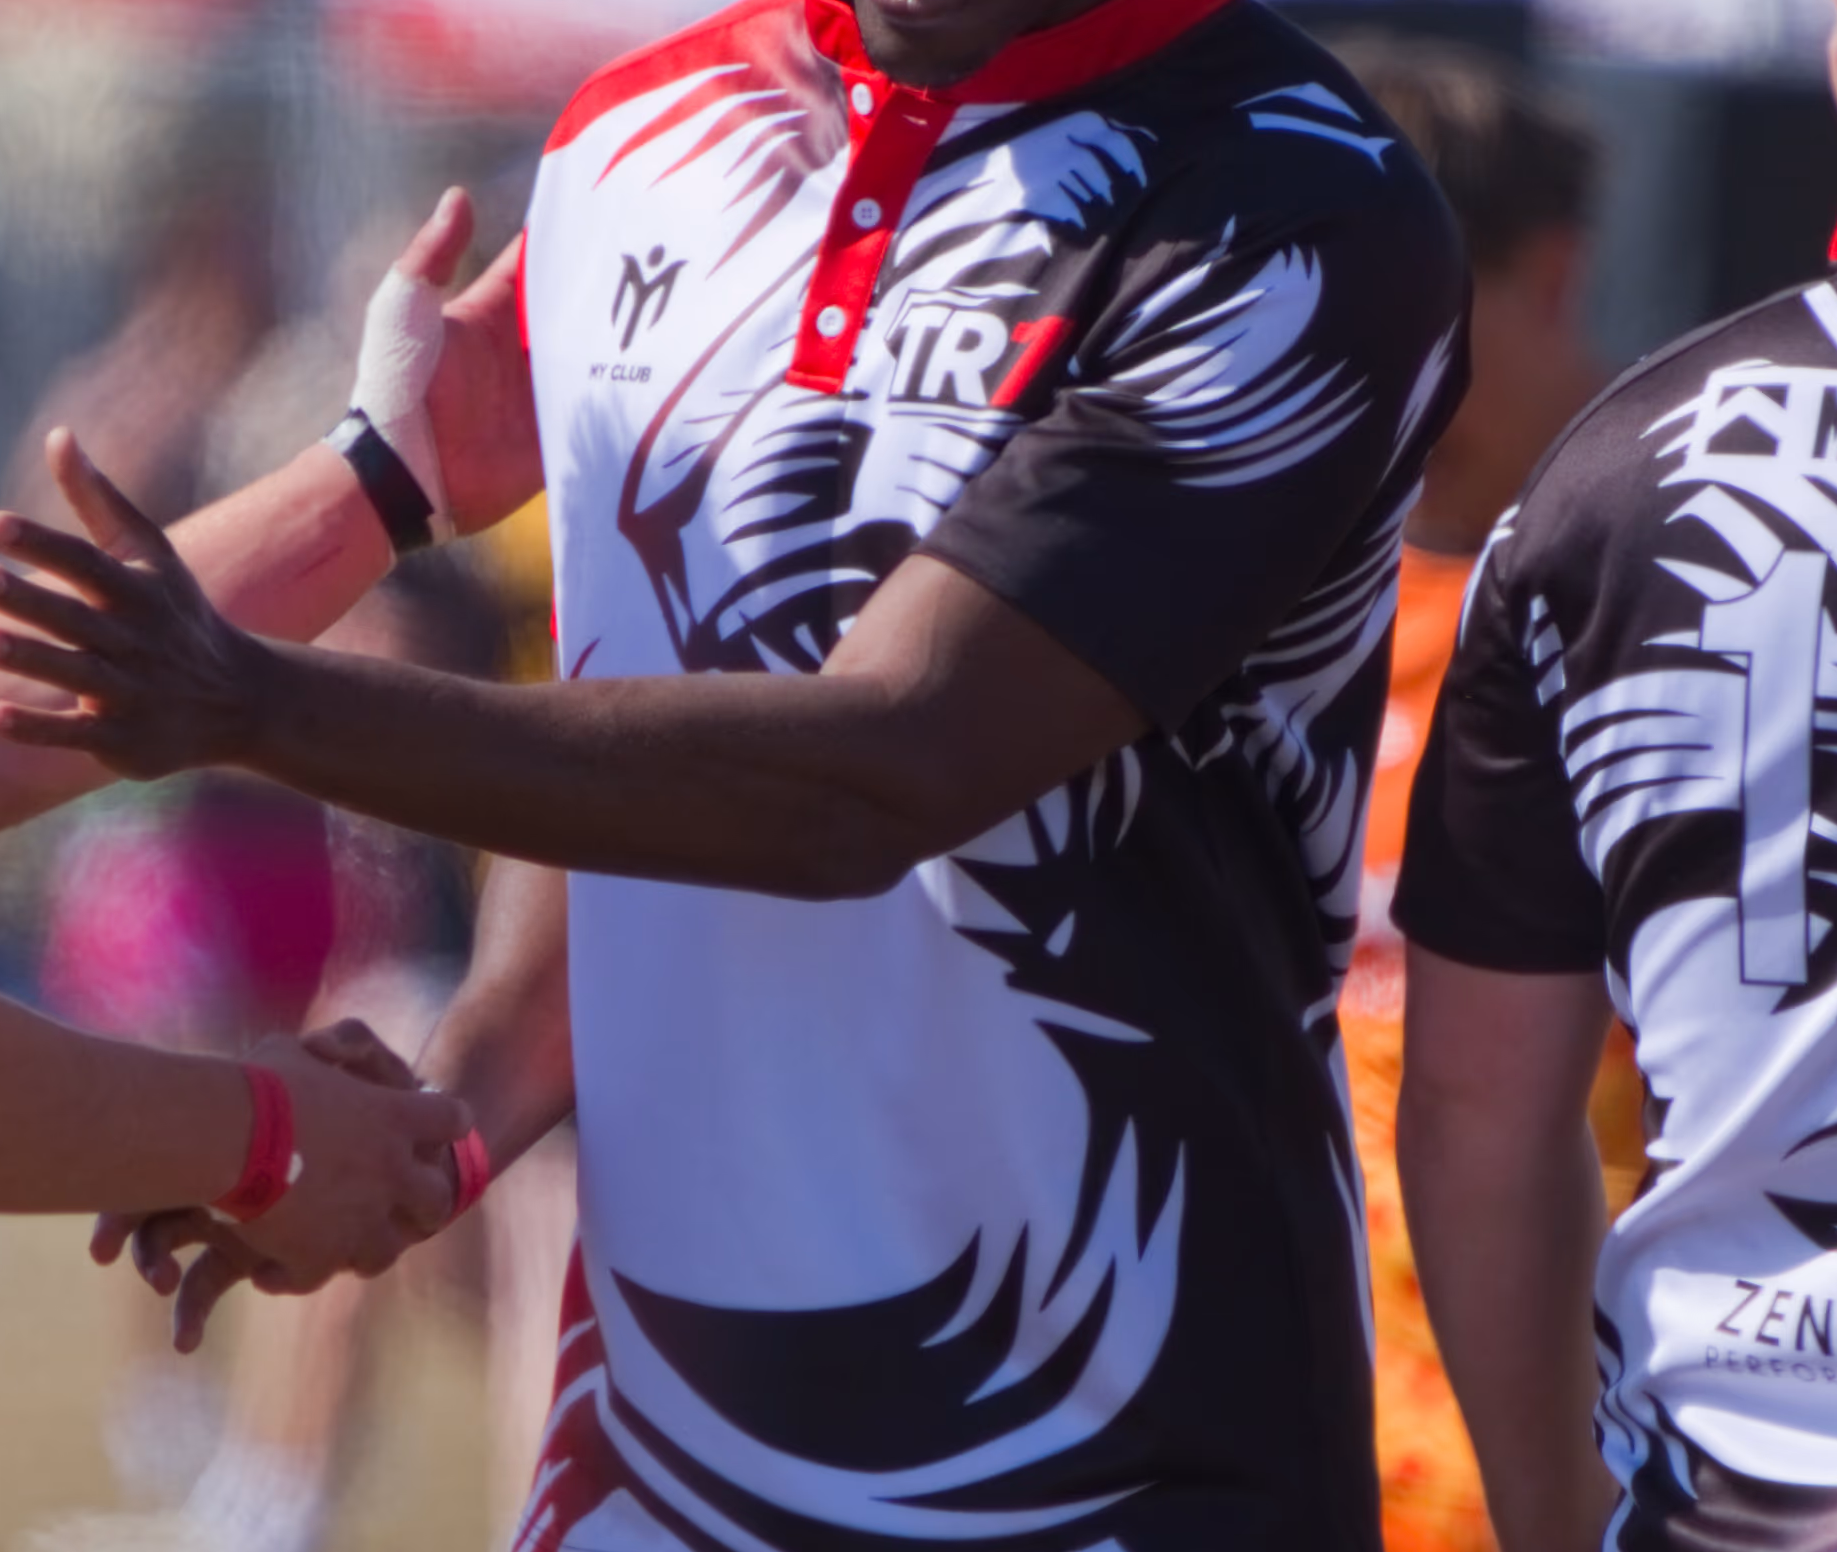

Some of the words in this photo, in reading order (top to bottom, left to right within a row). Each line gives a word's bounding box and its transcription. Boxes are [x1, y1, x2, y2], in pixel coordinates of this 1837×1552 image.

[589, 363, 608, 380] MY
[611, 365, 652, 383] CLUB
[890, 304, 1070, 408] TR1
